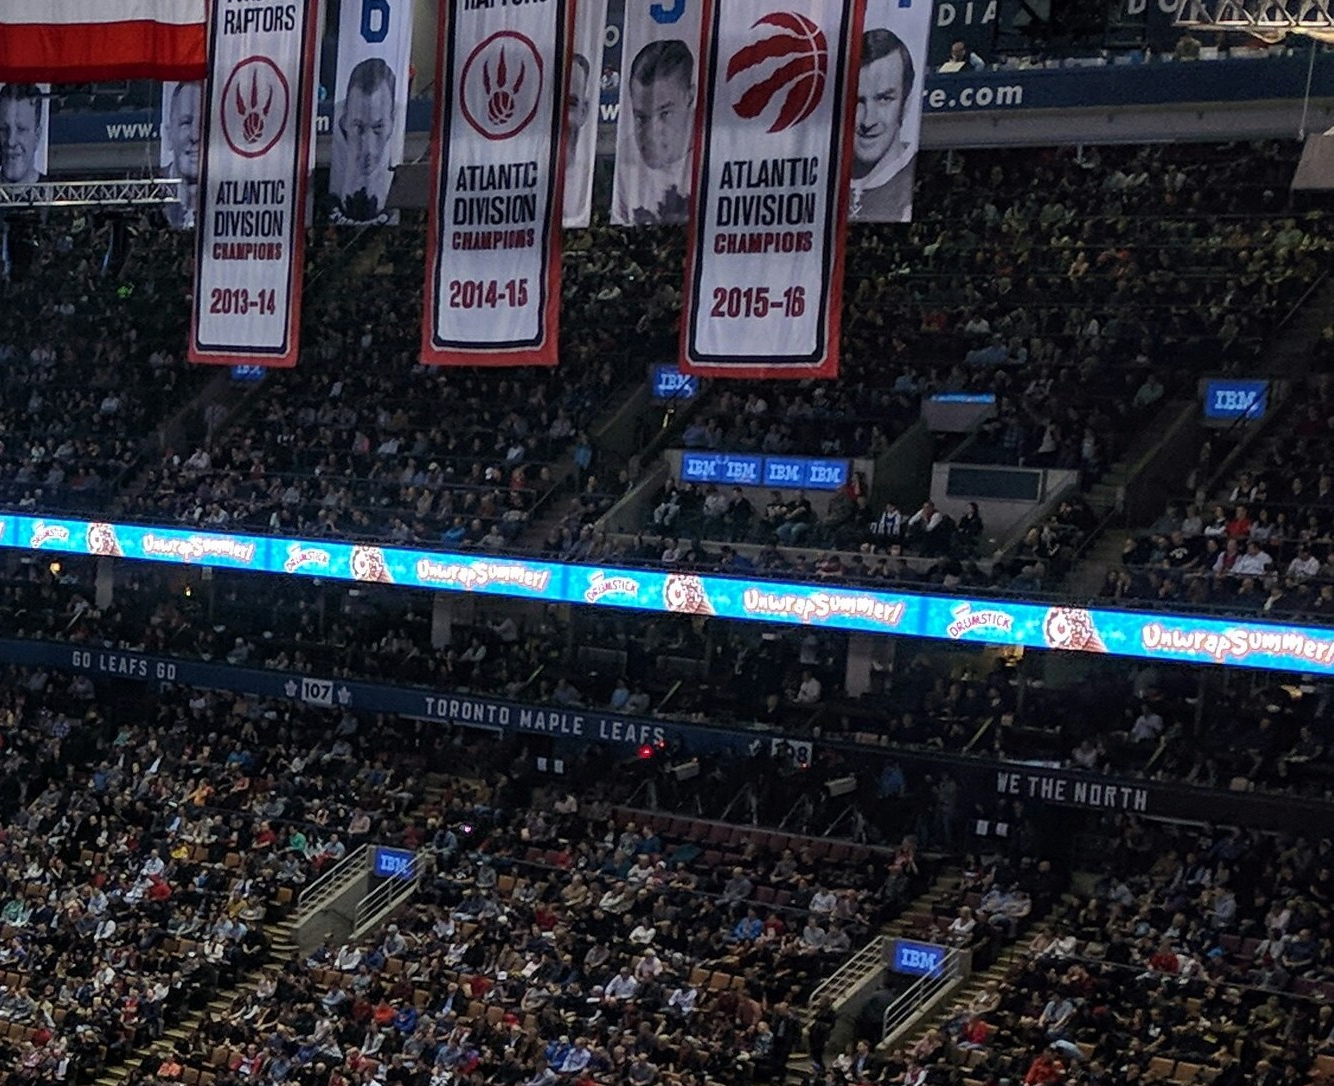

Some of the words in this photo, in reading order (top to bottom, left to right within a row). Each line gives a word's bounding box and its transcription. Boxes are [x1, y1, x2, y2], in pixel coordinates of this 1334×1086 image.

[224, 5, 296, 35] RAPTORS
[456, 162, 537, 191] ATLANTIC
[719, 156, 818, 189] ATLANTIC
[216, 179, 284, 206] ATLANTIC
[453, 195, 536, 225] DIVISION
[716, 193, 815, 226] DIVISION
[214, 210, 283, 237] DIVISION
[213, 243, 282, 261] CHAMPIONS
[452, 229, 534, 250] CHAMPIONS
[714, 231, 813, 254] CHAMPIONS
[210, 288, 276, 315] 2013-14
[450, 279, 528, 309] 2014-15
[710, 286, 805, 318] 2015-16
[1216, 390, 1257, 411] IBM
[687, 459, 716, 476] IBM
[726, 461, 756, 478] IBM
[769, 464, 799, 481] IBM
[810, 466, 840, 483] IBM
[950, 613, 1011, 638] DRUMSTICK
[72, 652, 91, 668] GO
[99, 655, 148, 676] LEAFS
[156, 663, 176, 680] GO
[304, 682, 331, 700] 107
[426, 697, 510, 725] TORONTO
[519, 709, 583, 735] MAPLE
[599, 720, 665, 746] LEAFS
[997, 772, 1020, 794] WE
[1028, 776, 1067, 800] THE
[1074, 782, 1147, 811] NORTH
[380, 854, 408, 873] IBM
[901, 951, 936, 970] IBM
